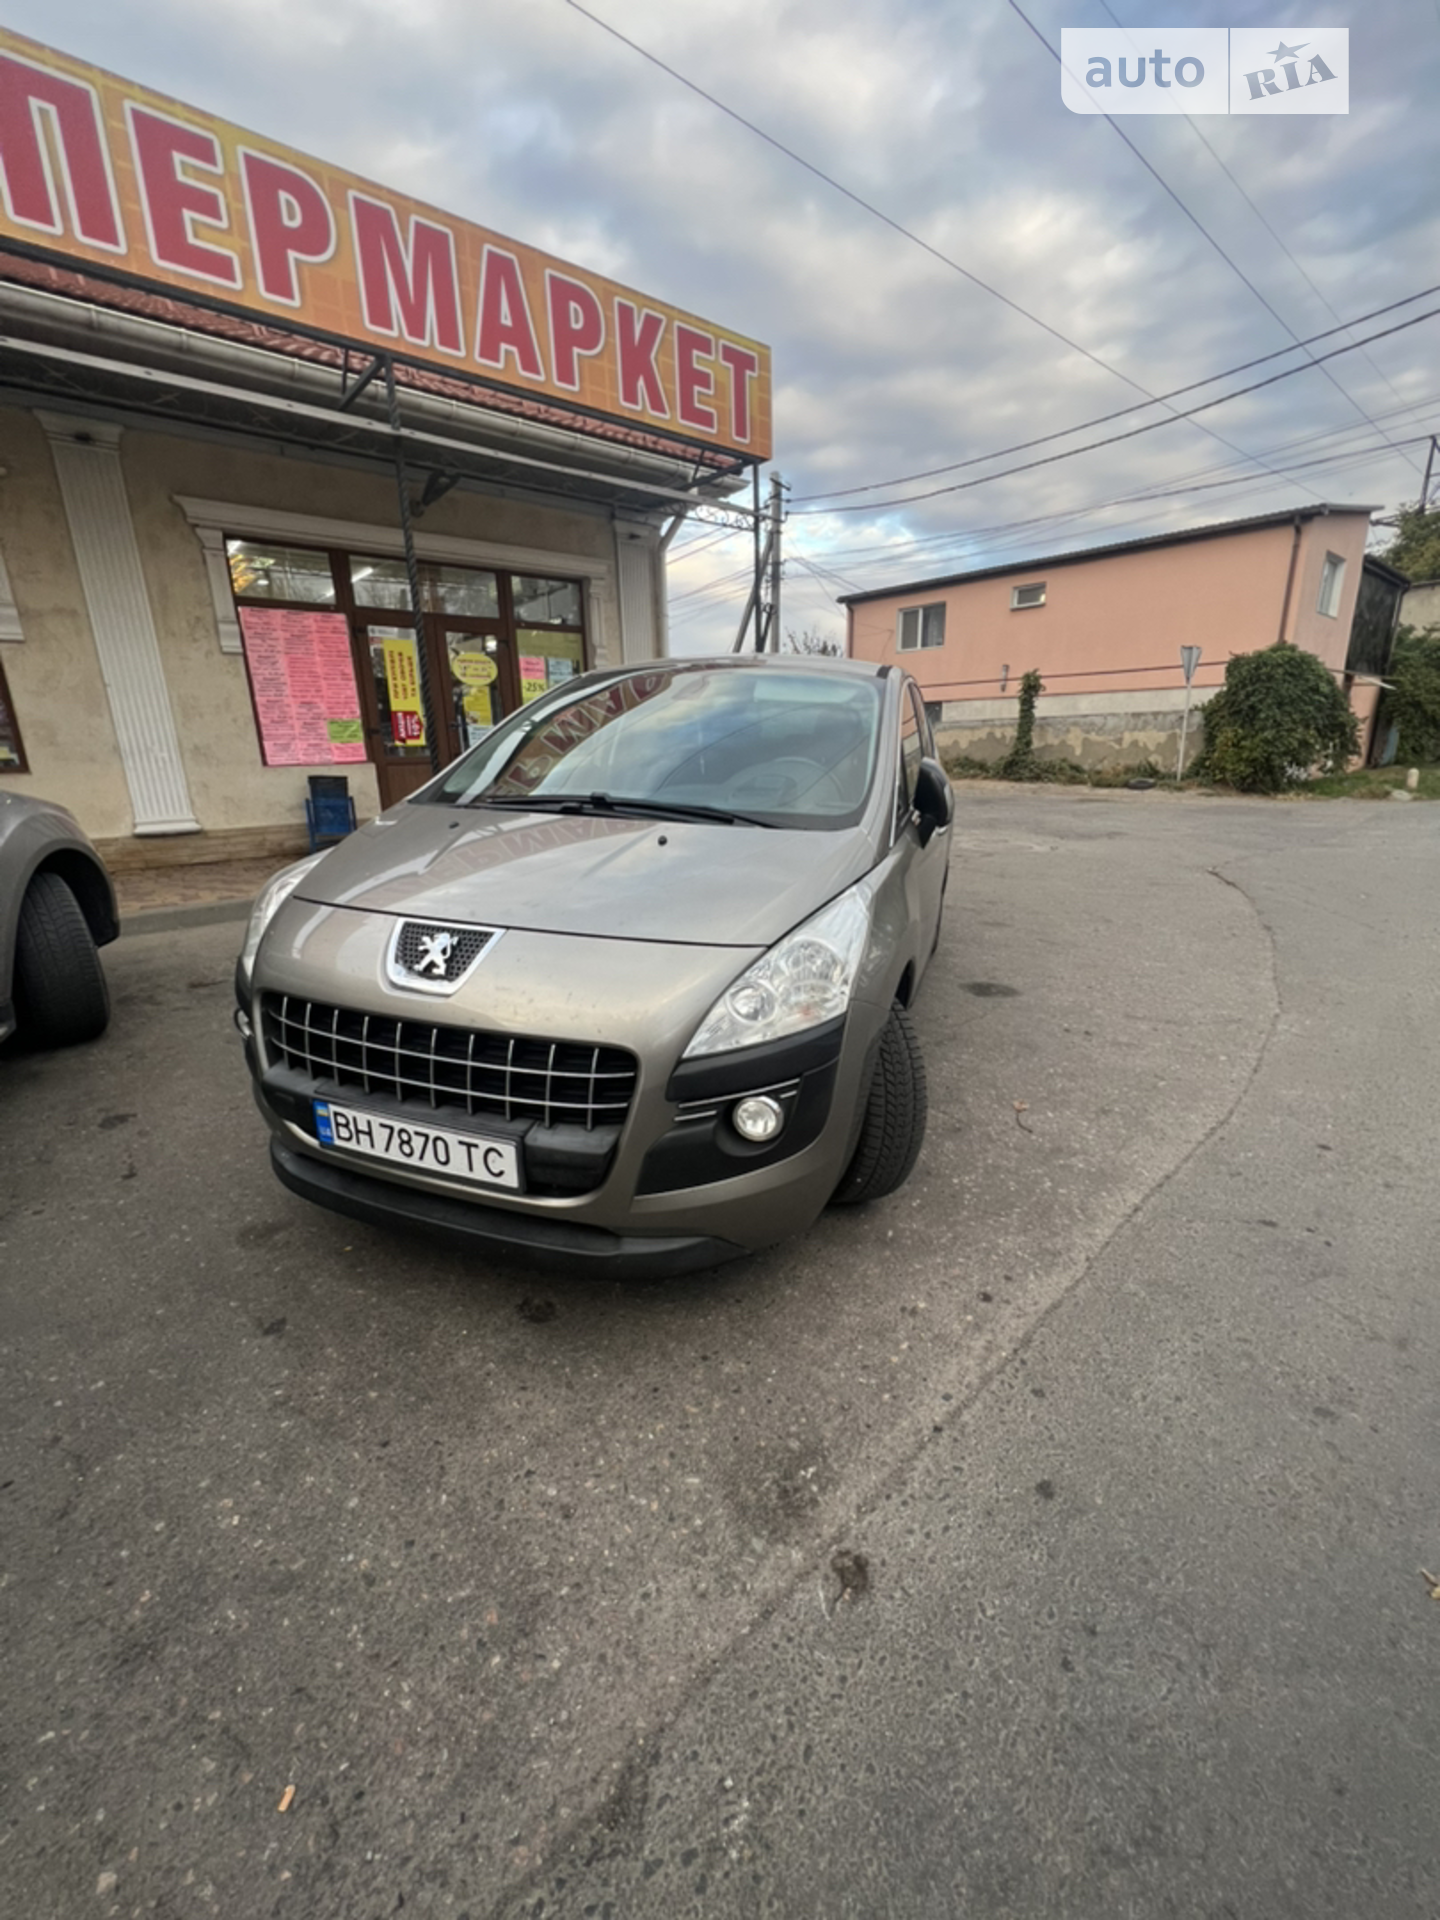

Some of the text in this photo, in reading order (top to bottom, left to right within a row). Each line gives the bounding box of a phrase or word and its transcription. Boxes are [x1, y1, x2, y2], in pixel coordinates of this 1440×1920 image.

[0, 47, 758, 444] ПЕРМАРКЕТ
[333, 1110, 505, 1178] BH 7870 TC
